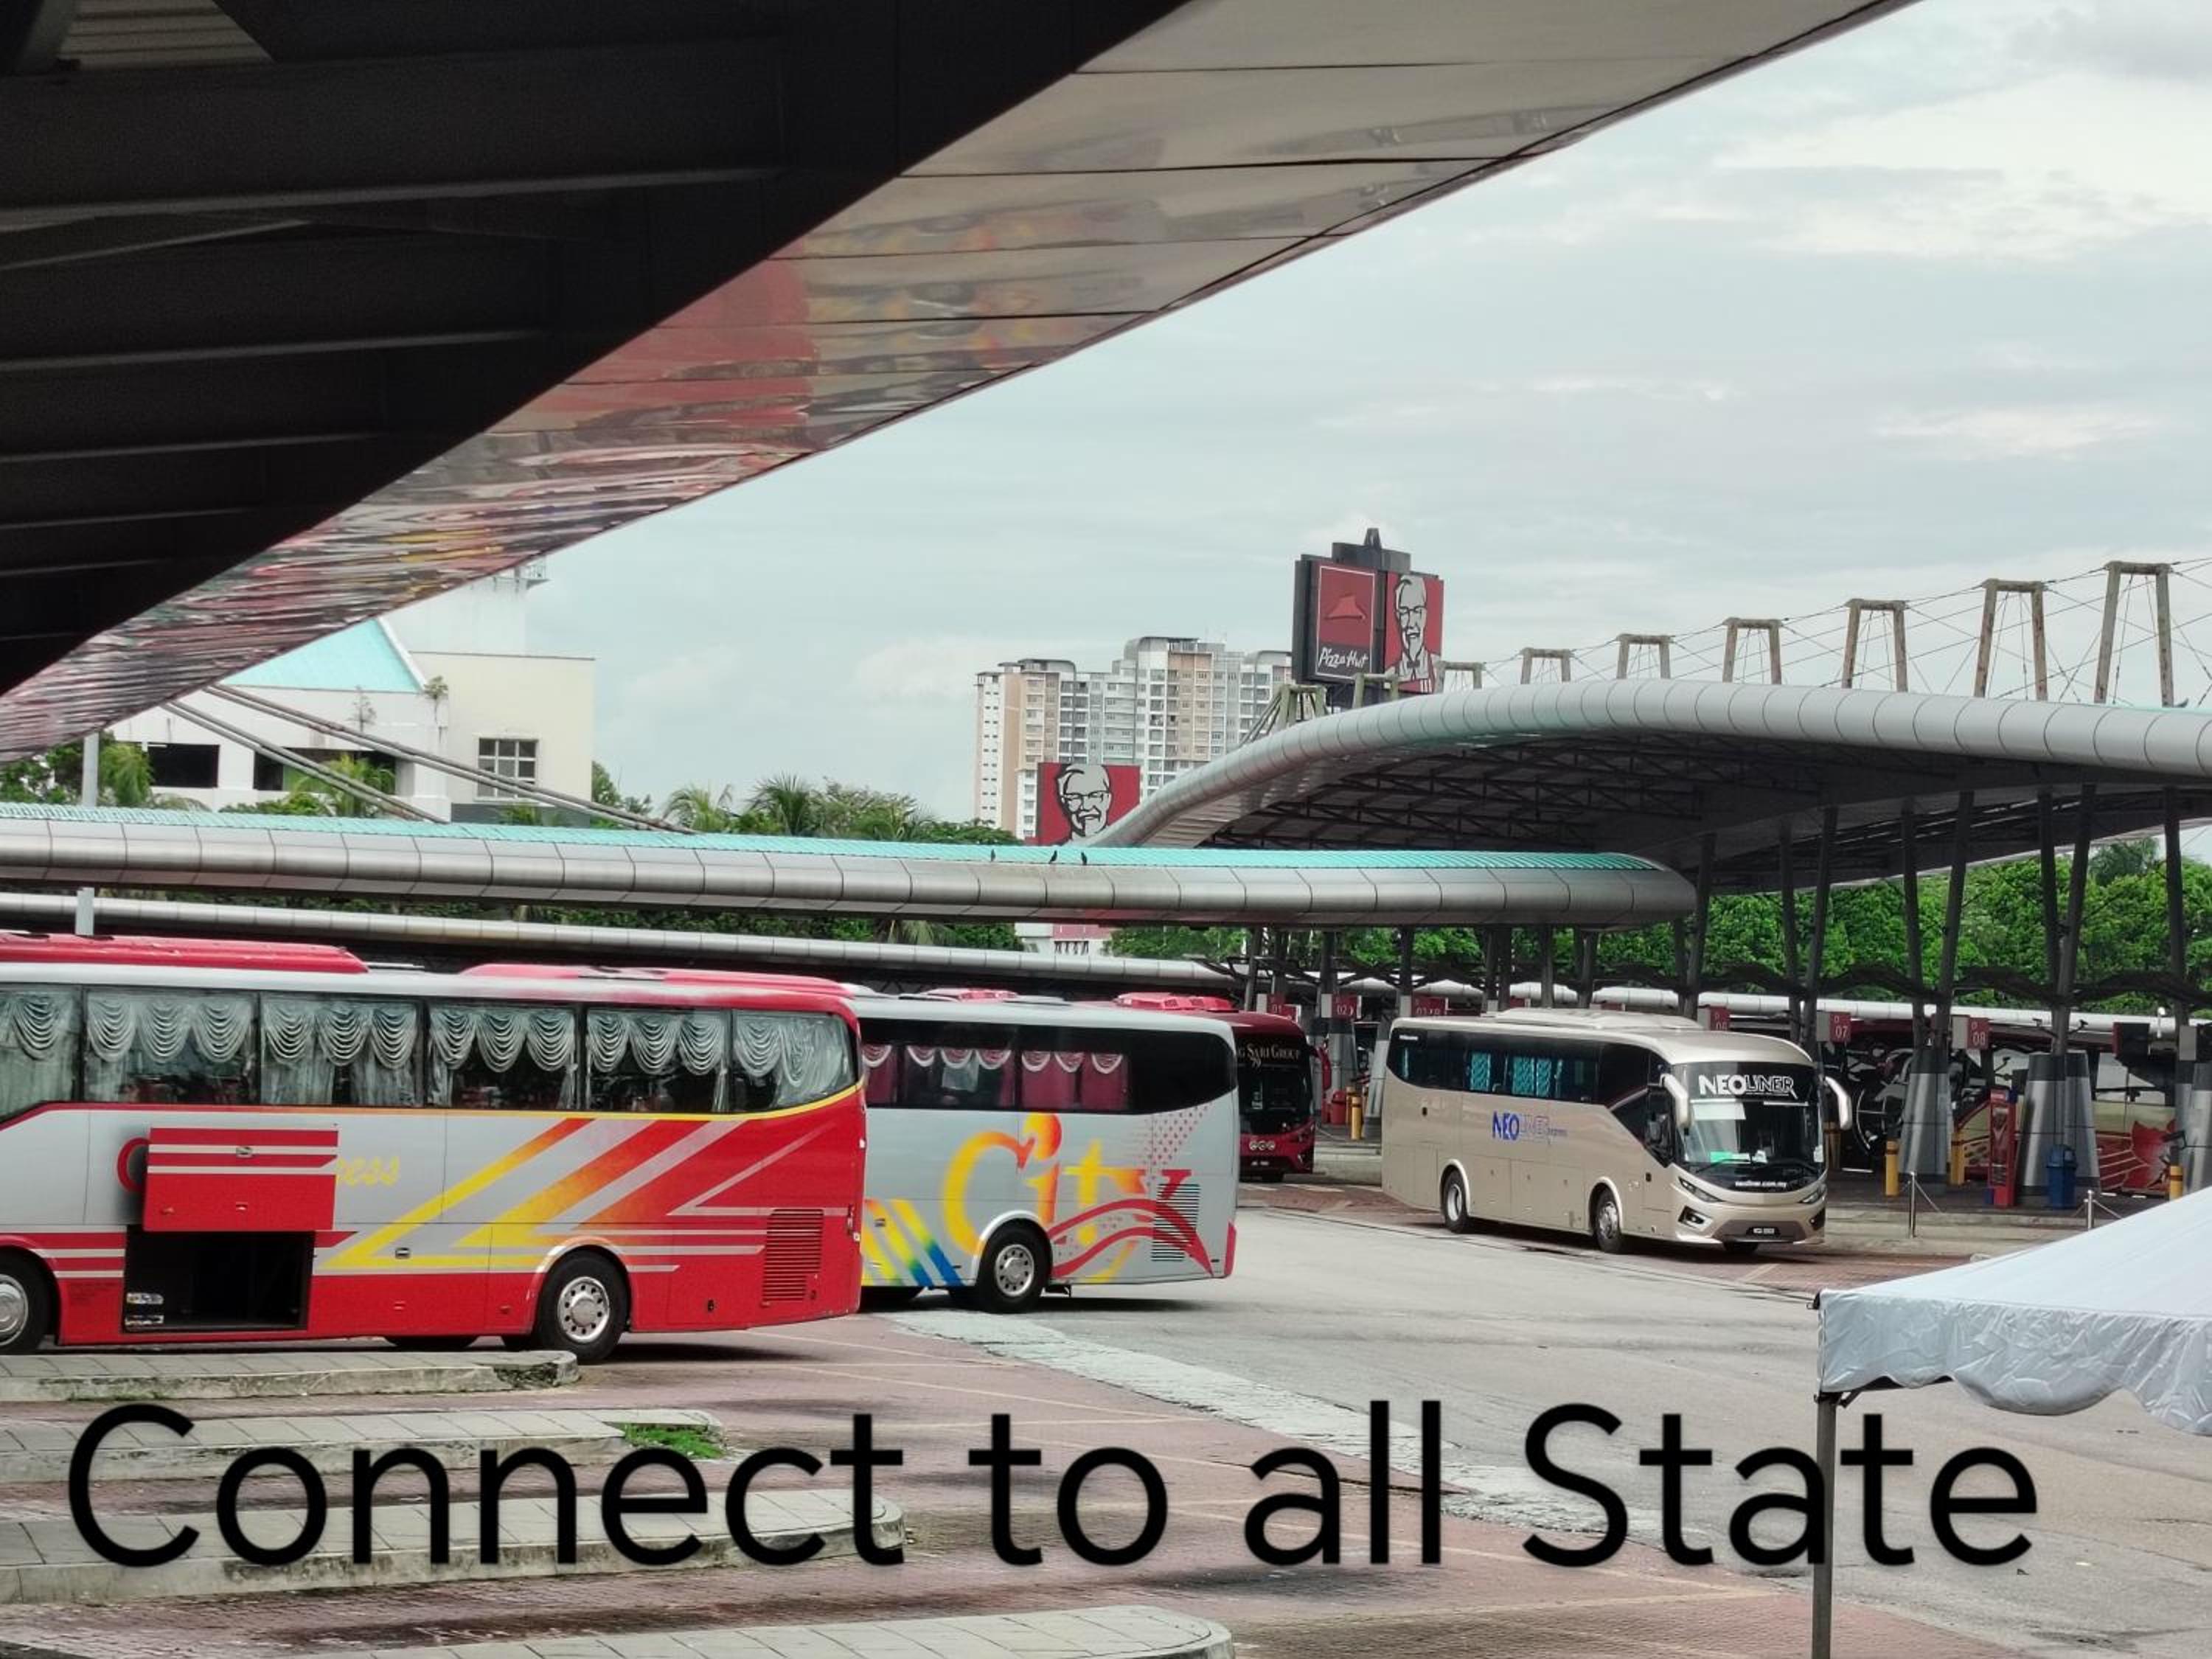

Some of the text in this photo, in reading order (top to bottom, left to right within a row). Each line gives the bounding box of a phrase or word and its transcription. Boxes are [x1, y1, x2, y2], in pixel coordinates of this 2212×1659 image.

[1318, 647, 1368, 669] Pizza Hut
[1835, 1026, 1848, 1039] 07
[1698, 1074, 1798, 1099] NEOLINER
